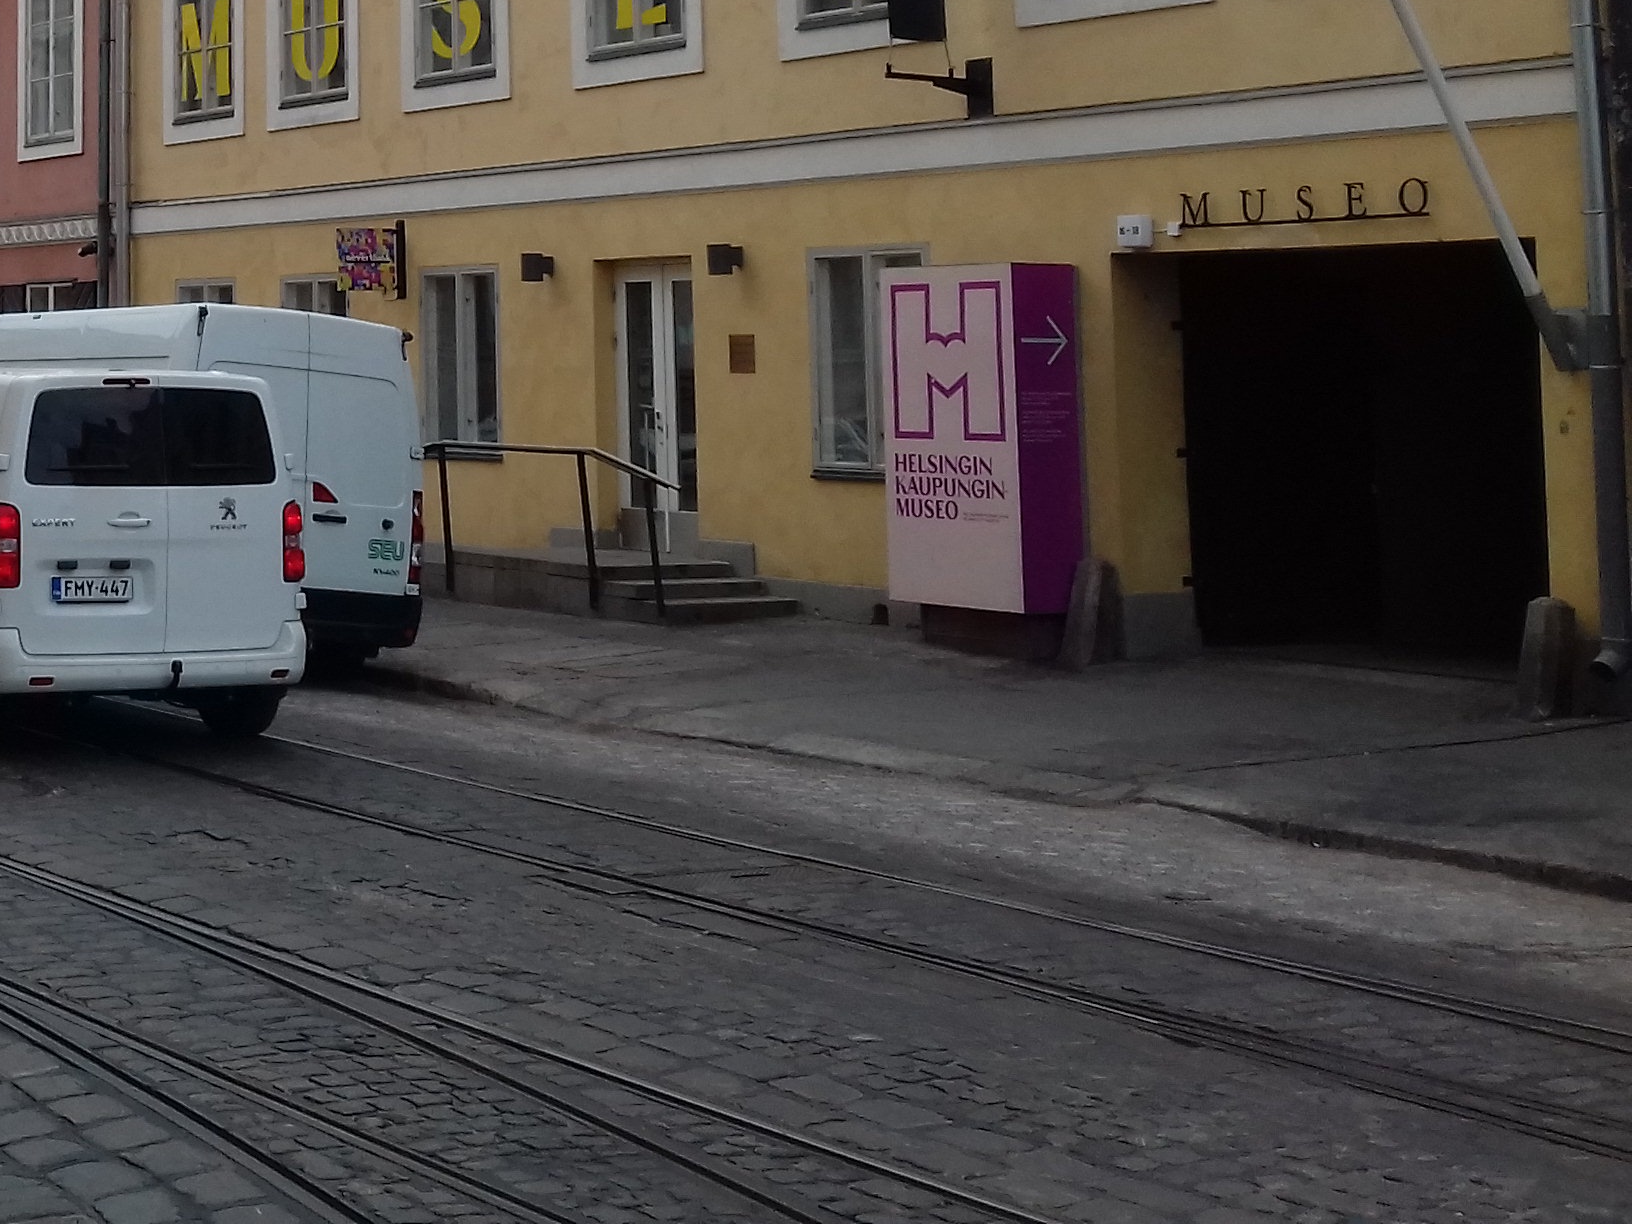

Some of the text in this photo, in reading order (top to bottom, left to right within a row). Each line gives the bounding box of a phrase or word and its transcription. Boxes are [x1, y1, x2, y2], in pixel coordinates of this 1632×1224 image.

[1179, 177, 1429, 226] MUSEO
[894, 452, 993, 476] HELSINGIN
[895, 497, 959, 520] MUSEO
[31, 517, 76, 527] EXPERT
[63, 579, 130, 598] FMY-447
